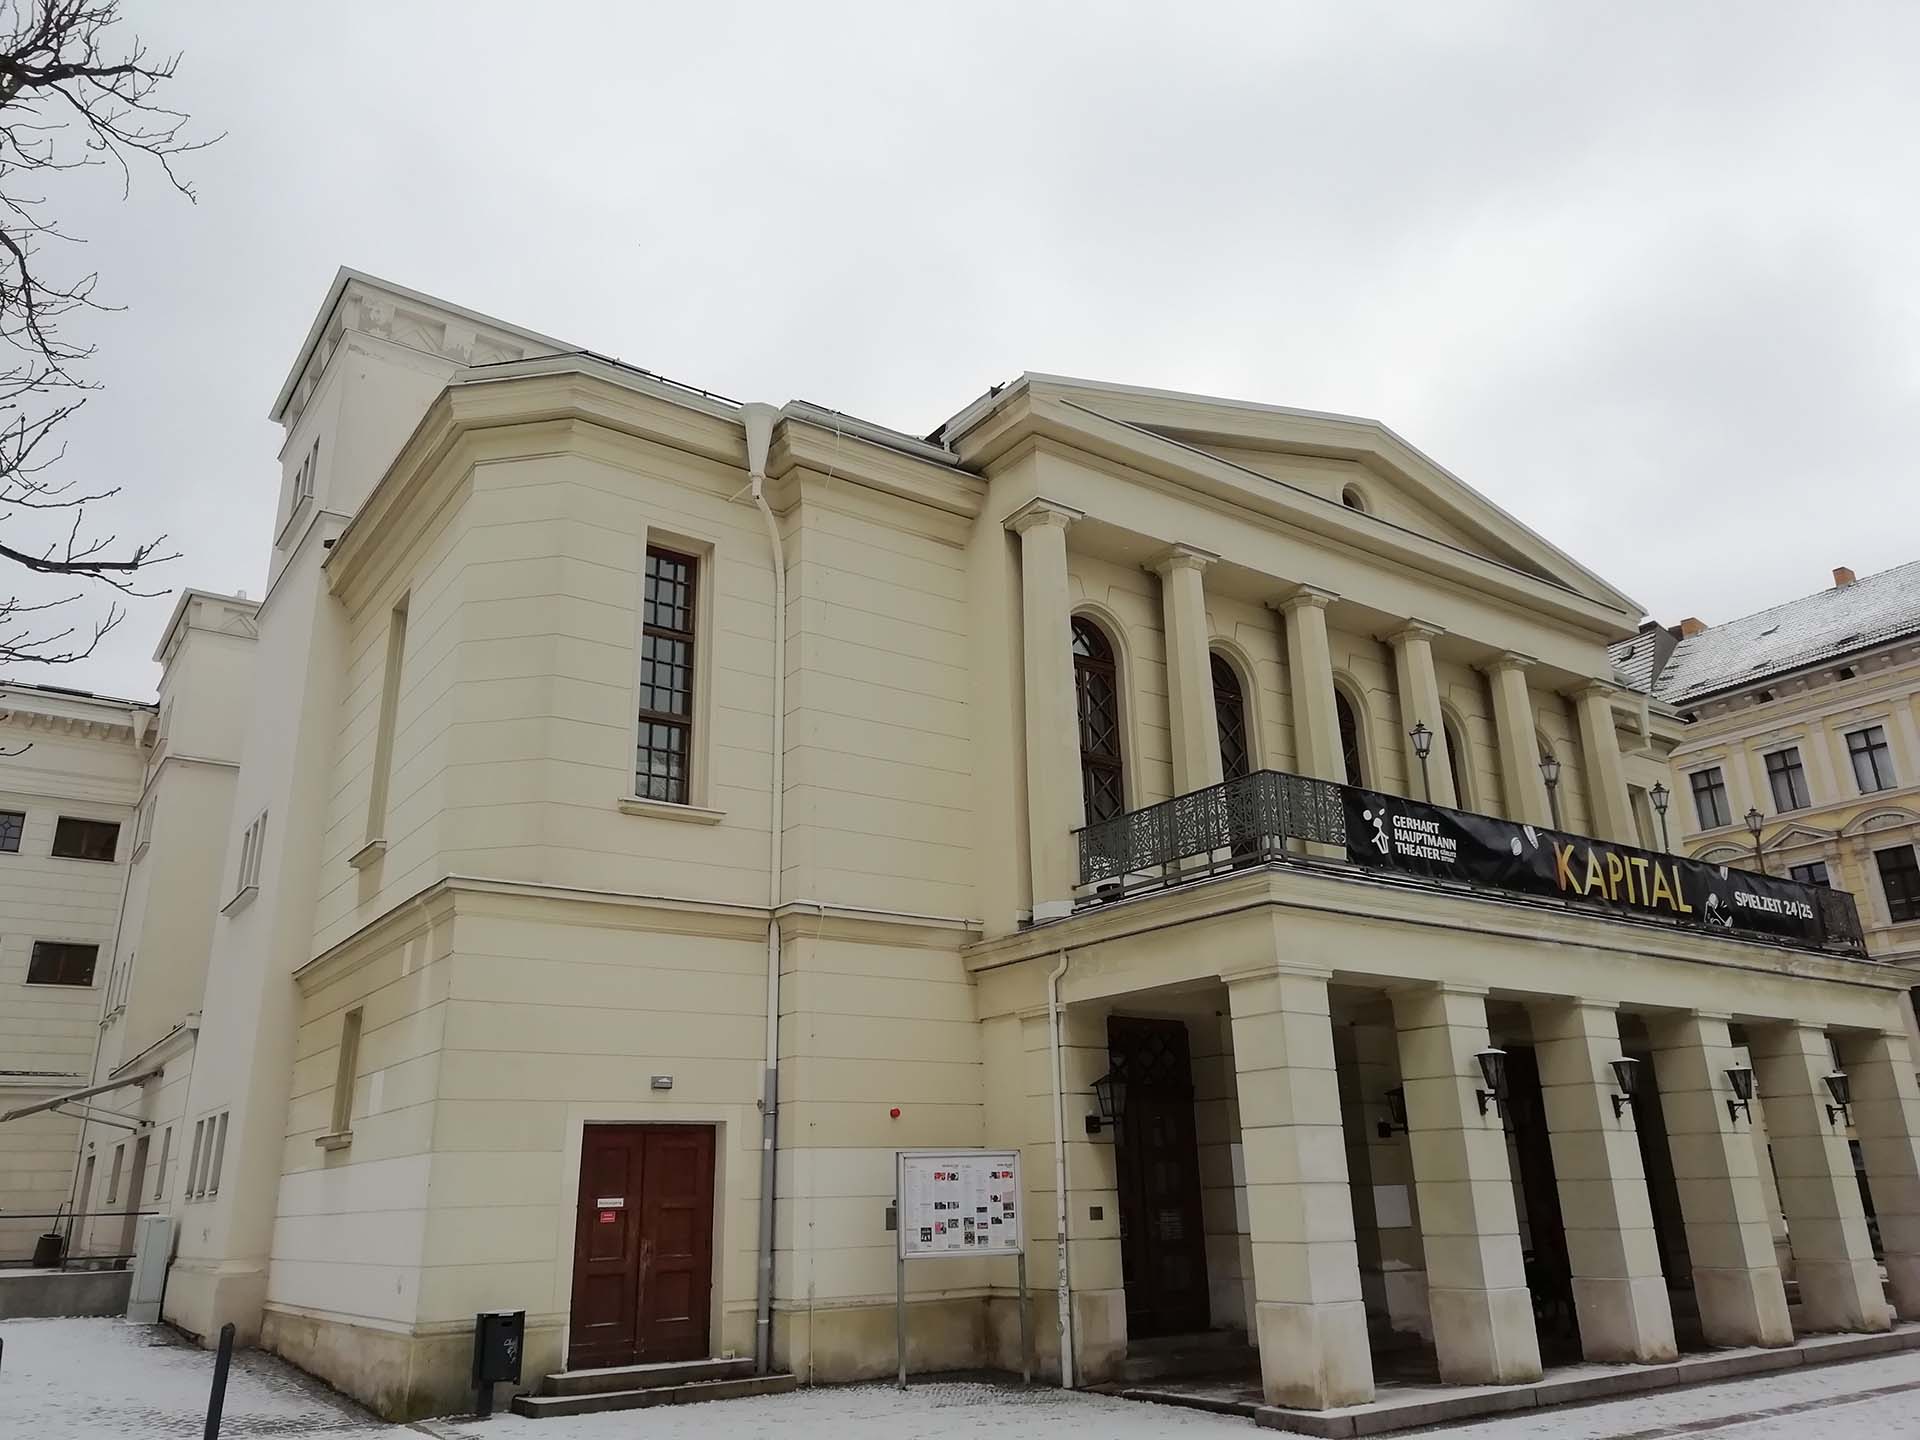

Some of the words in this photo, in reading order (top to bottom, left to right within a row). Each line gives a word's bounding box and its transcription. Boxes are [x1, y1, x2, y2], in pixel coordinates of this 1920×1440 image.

[1392, 815, 1440, 834] GERHART
[1393, 828, 1457, 851] HAUPTMANN
[1394, 841, 1441, 860] THEATER
[1553, 841, 1693, 913] KAPITAL
[1734, 890, 1783, 914] SPIELZEIT
